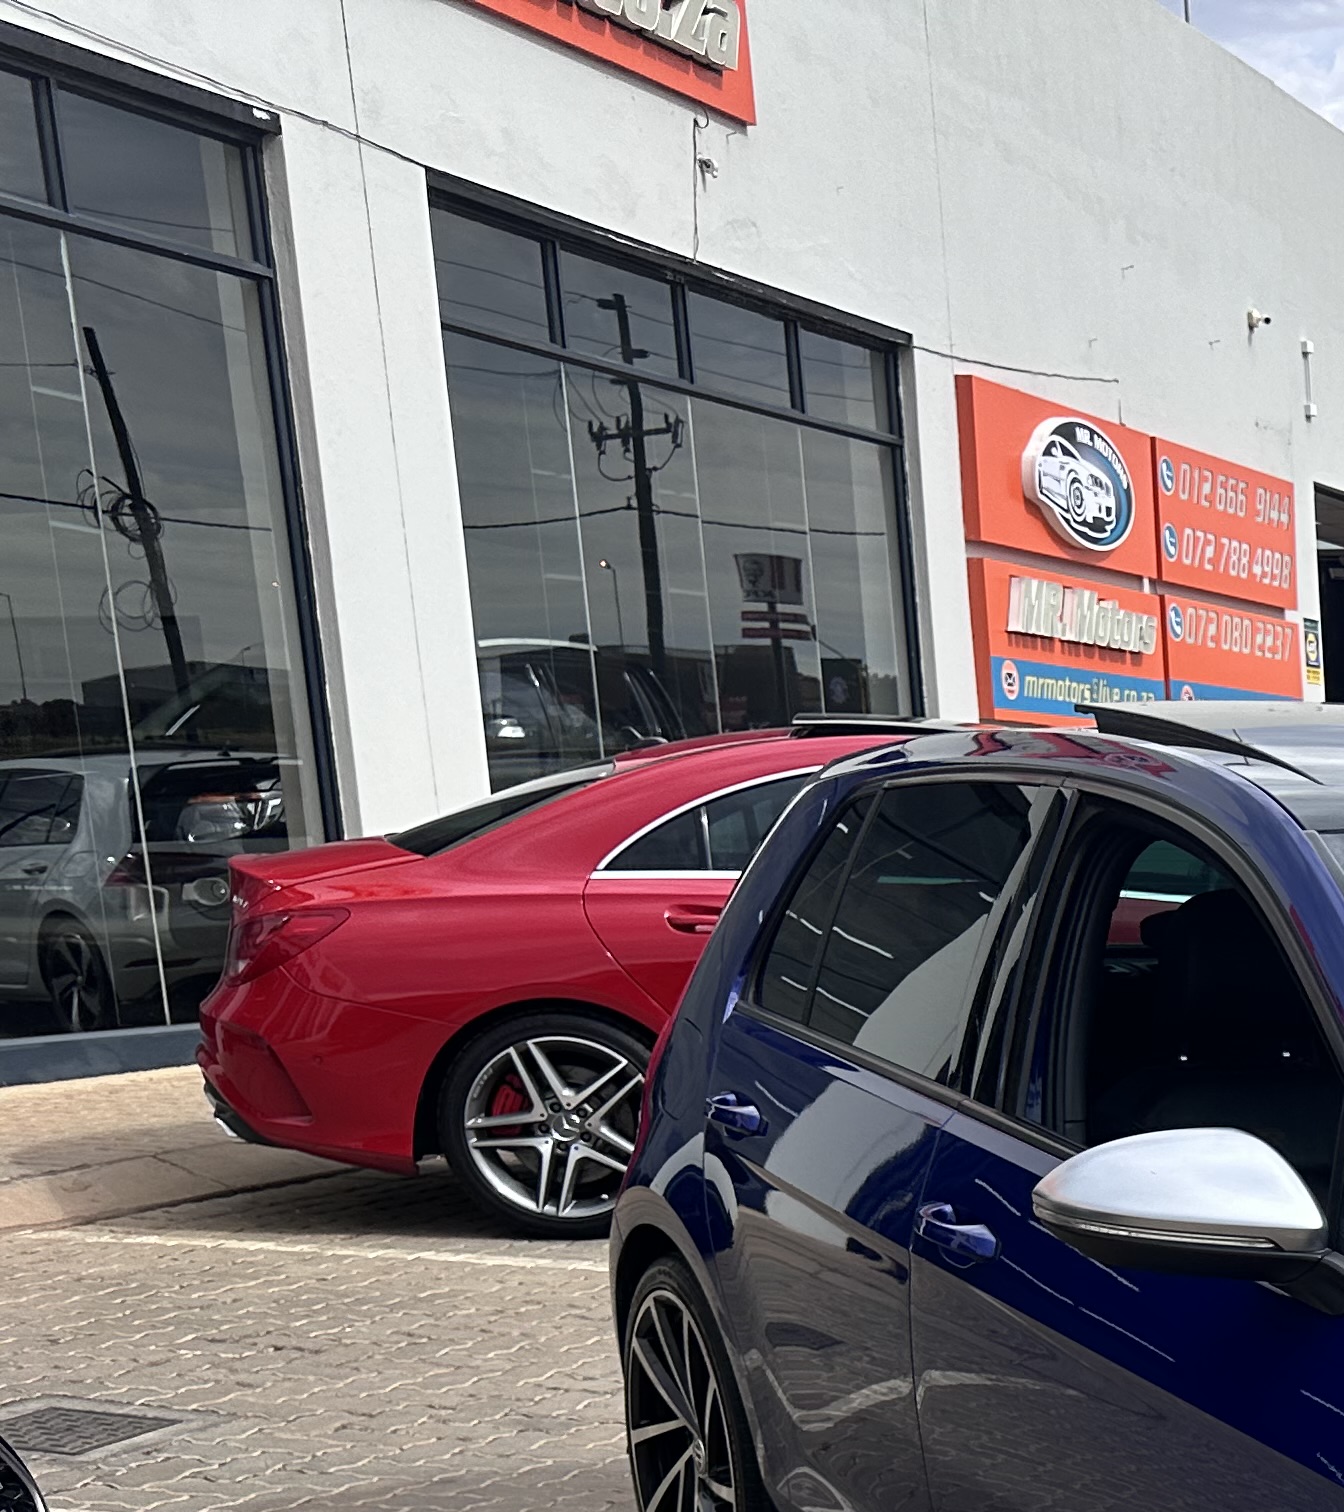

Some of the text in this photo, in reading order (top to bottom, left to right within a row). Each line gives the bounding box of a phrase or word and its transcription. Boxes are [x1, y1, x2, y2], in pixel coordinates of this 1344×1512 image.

[1179, 462, 1291, 530] 012 666 9144
[1182, 527, 1292, 590] 072 788 4998
[1008, 576, 1157, 655] MR. Motors
[1185, 607, 1218, 648] 072
[1221, 614, 1252, 654] 080
[1255, 621, 1293, 662] 2237
